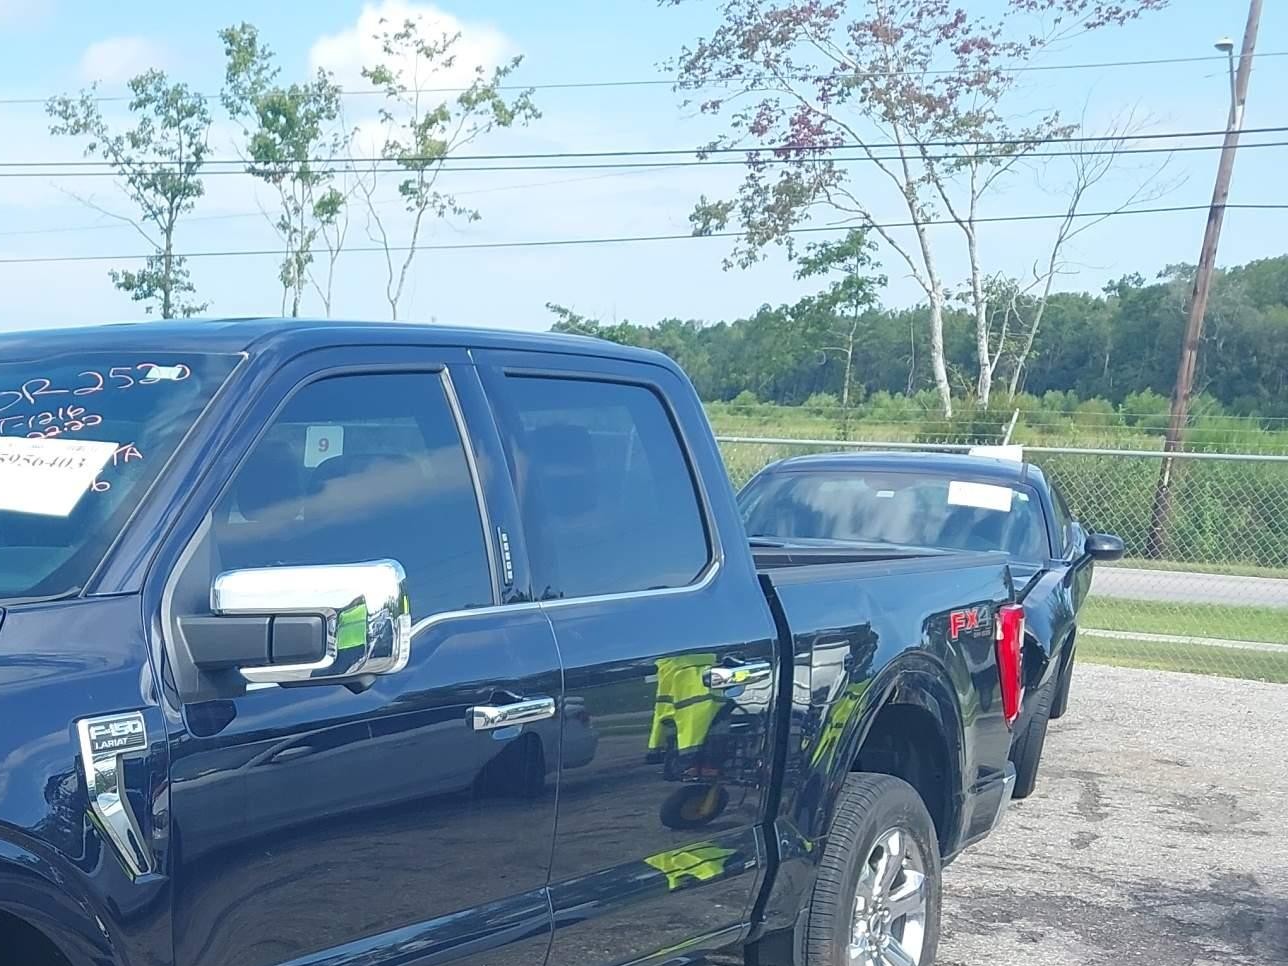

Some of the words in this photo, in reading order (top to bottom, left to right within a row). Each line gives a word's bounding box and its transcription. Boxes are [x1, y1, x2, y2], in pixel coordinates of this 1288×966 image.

[317, 437, 330, 453] 9
[949, 605, 993, 642] FX4
[89, 720, 143, 740] F-150
[95, 737, 128, 750] LARIAT
